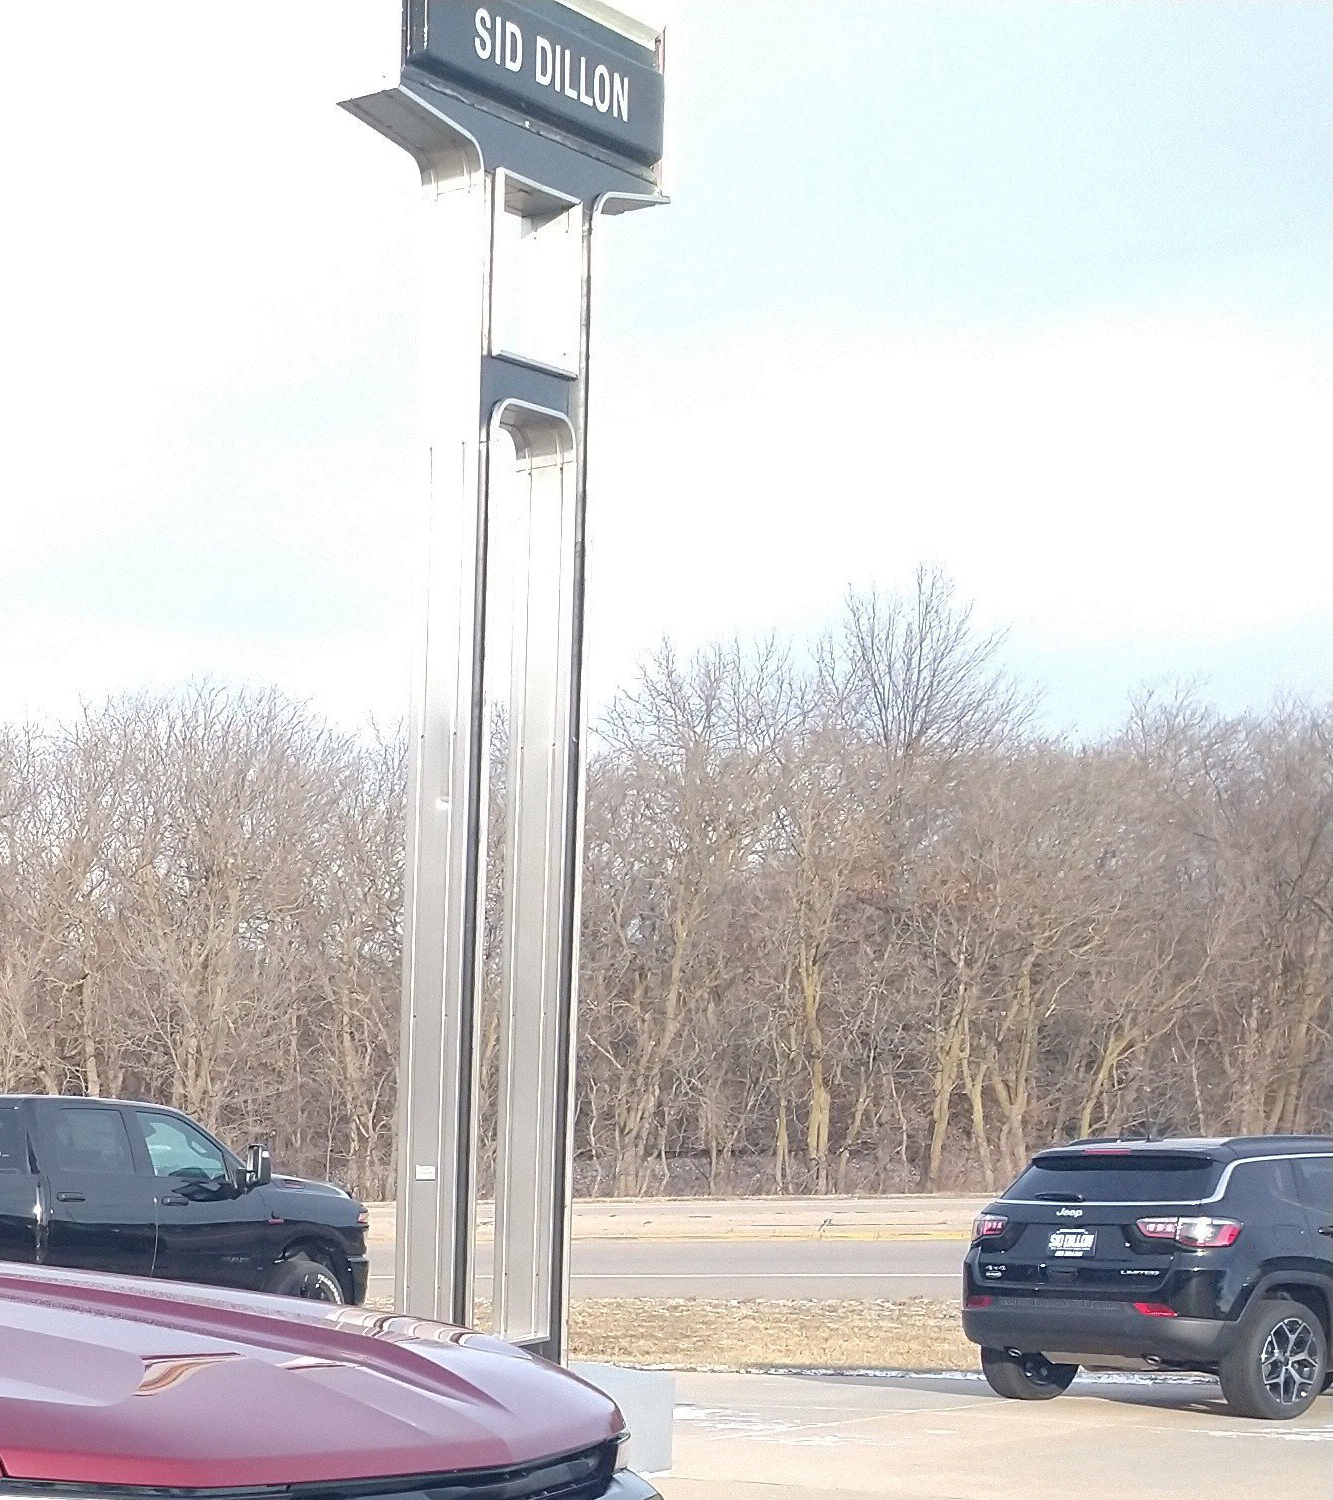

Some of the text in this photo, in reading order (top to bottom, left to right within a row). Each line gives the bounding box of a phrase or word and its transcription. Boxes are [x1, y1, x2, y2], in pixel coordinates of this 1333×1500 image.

[474, 7, 630, 122] SID DILLON
[1056, 1207, 1083, 1218] Jeep
